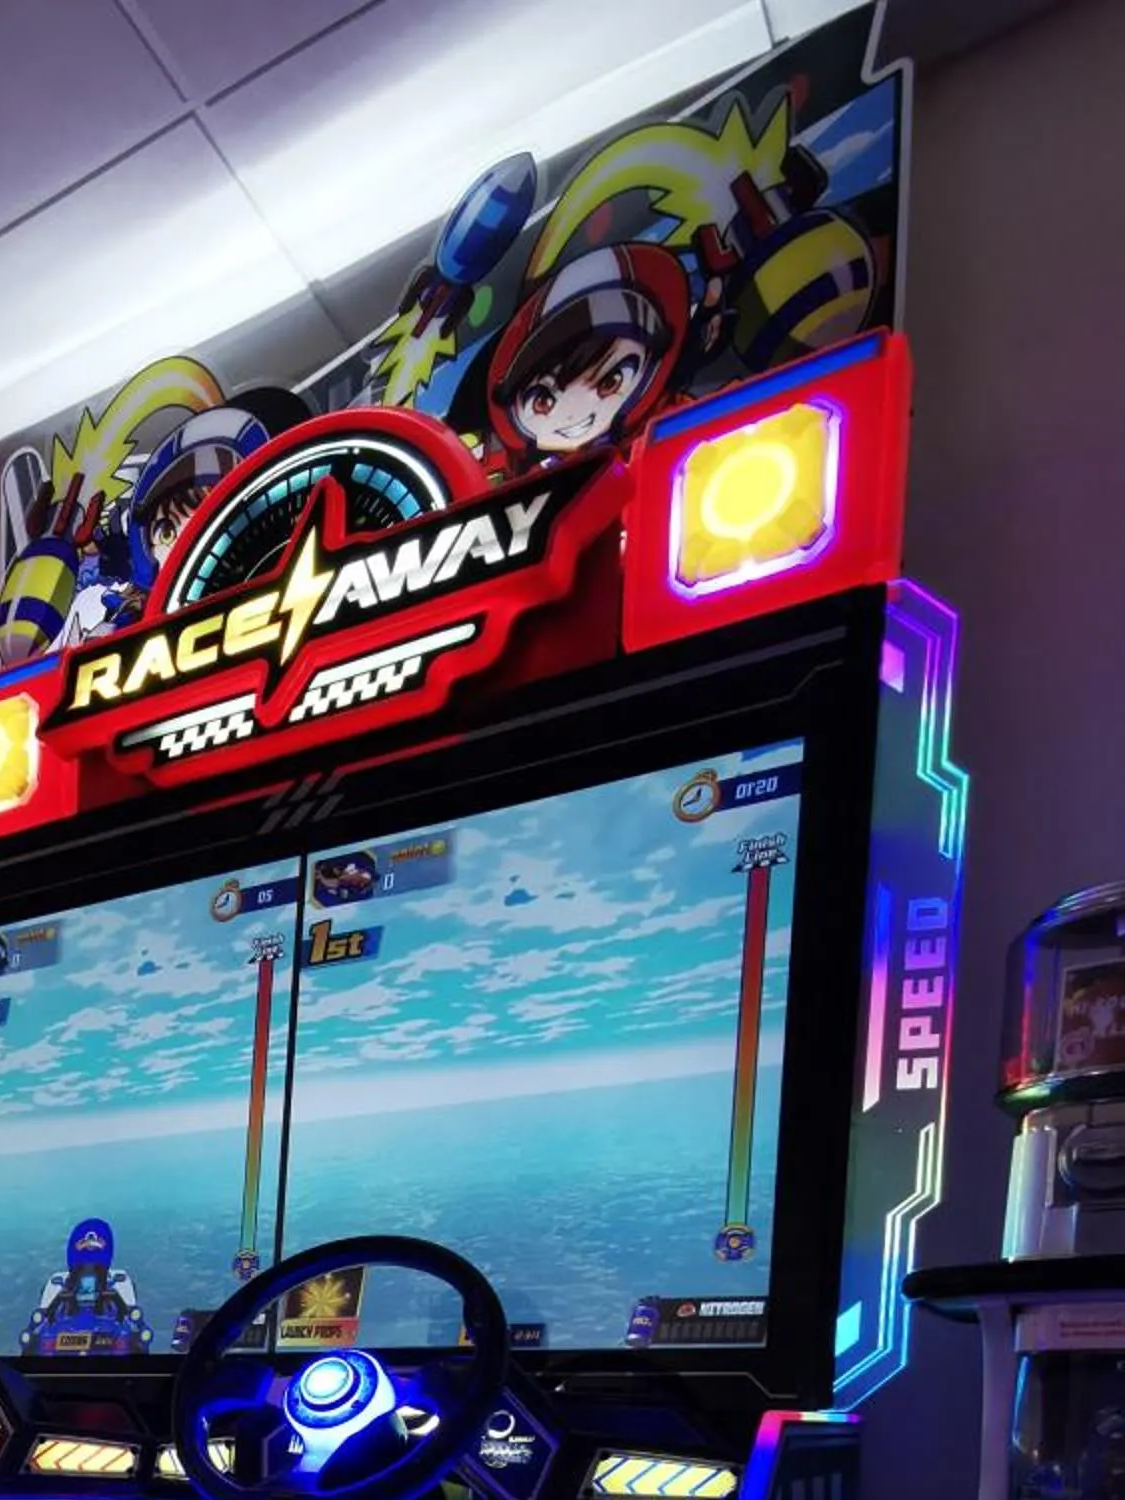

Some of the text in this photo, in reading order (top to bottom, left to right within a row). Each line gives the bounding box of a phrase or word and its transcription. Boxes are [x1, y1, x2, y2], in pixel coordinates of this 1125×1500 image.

[69, 491, 553, 710] RACE AWAY
[309, 919, 366, 966] 1st
[896, 897, 949, 1092] SPEED
